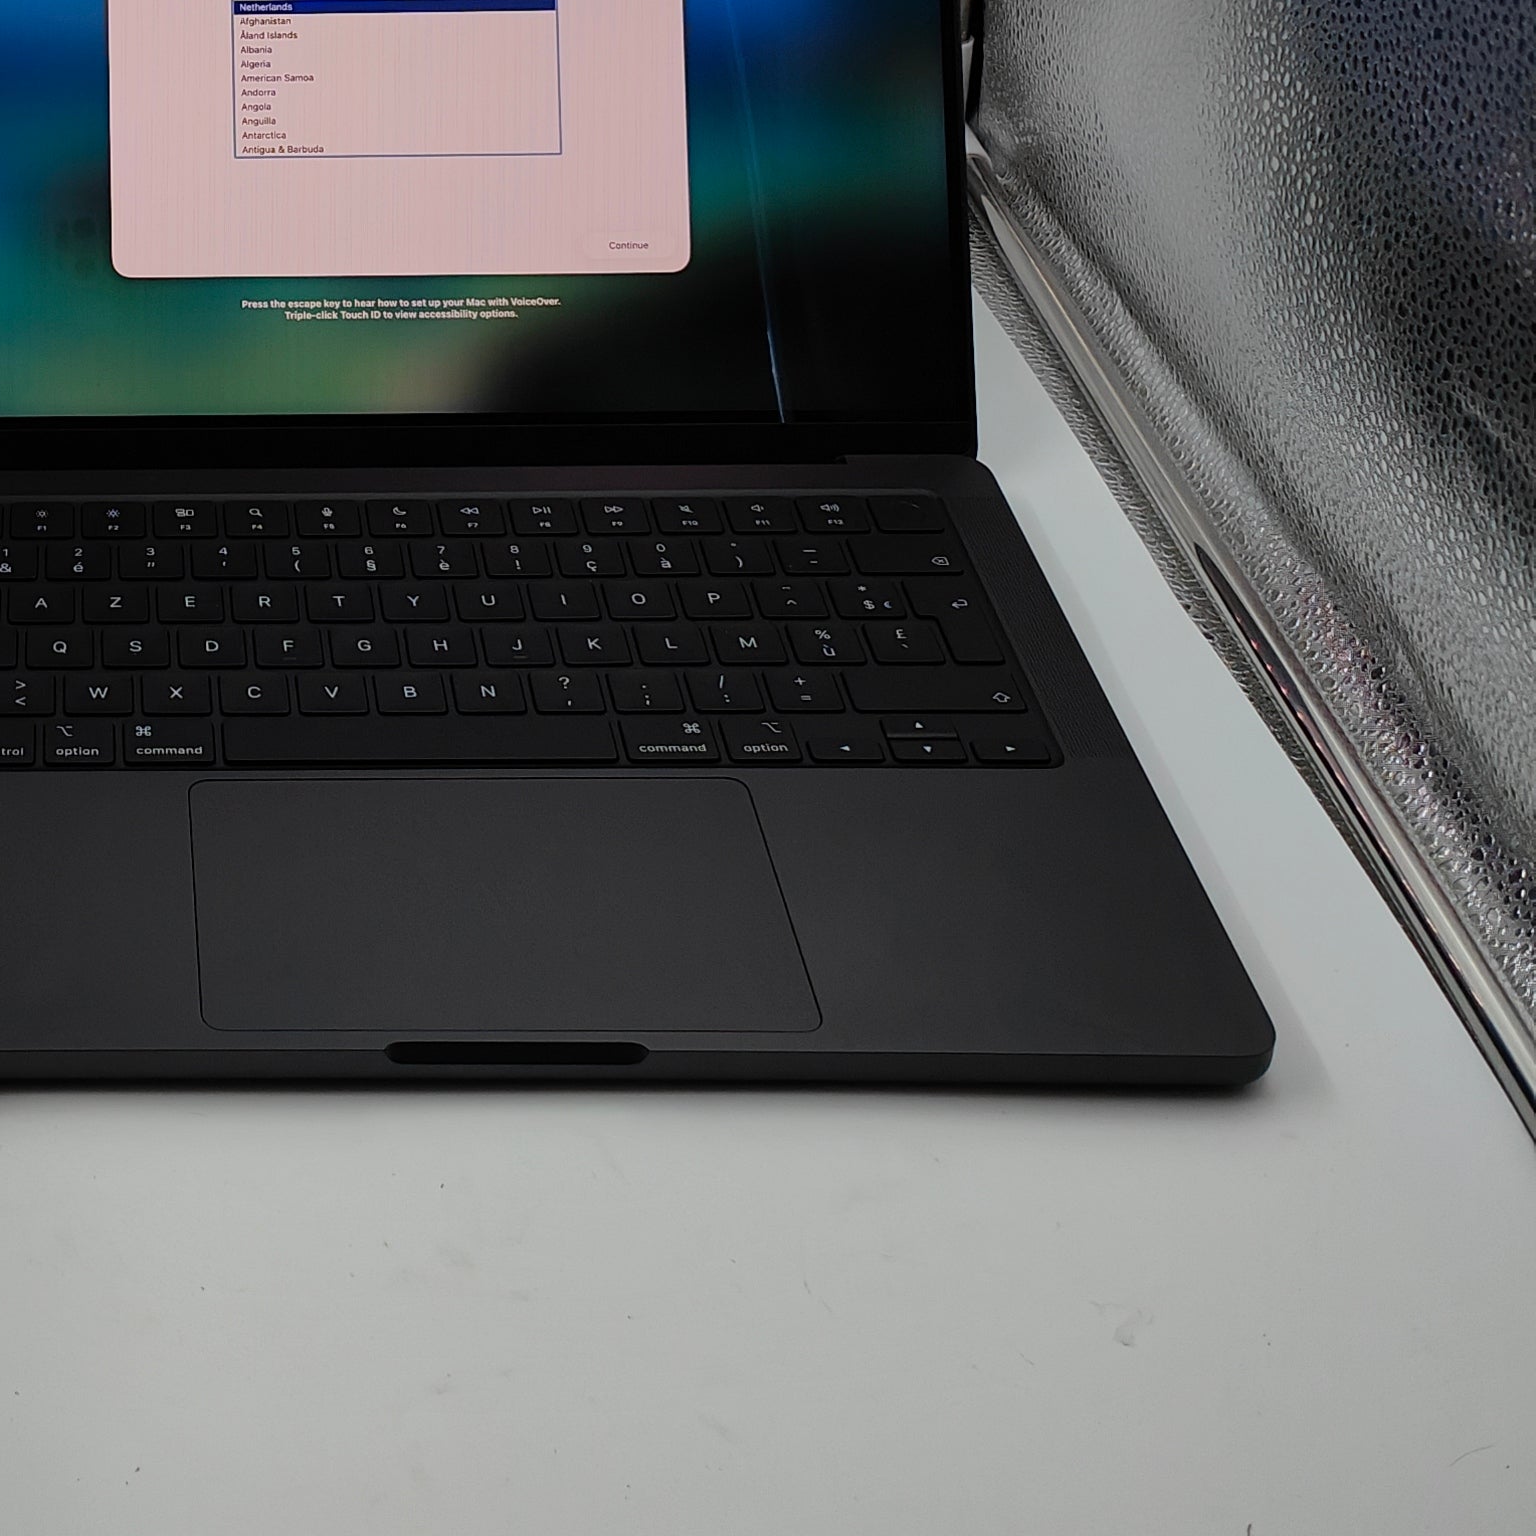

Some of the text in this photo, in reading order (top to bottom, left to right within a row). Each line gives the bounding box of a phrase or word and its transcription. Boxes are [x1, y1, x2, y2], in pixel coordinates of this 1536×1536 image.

[239, 2, 293, 12] Netherlands
[240, 17, 292, 27] Afghanistan
[266, 31, 298, 39] Islands
[240, 45, 273, 54] Albania
[240, 60, 271, 70] Algeria
[240, 73, 314, 82] American Samoa
[241, 88, 276, 97] Andorra
[241, 102, 272, 112] Angola
[241, 117, 276, 126] Anguilla
[242, 131, 287, 139] Antarctica
[242, 145, 324, 155] Antigua & Barbuda
[608, 240, 650, 250] Continue
[241, 297, 561, 310] Press the escape key to hear how to set up your Mac with VoiceOver.
[284, 309, 519, 321] Triple-click Touch ID to view accessibility options.
[2, 548, 8, 557] 1
[74, 548, 83, 557] 2
[146, 547, 155, 556] 3
[218, 547, 228, 555] 4
[291, 546, 301, 556] 5
[364, 546, 374, 555] 6
[437, 545, 446, 555] 7
[510, 545, 520, 554] 8
[582, 544, 593, 553] 9
[655, 543, 666, 553] 0
[73, 561, 84, 573] é
[439, 559, 450, 571] è
[34, 597, 48, 609] A
[109, 596, 122, 608] Z
[184, 595, 196, 608] E
[258, 595, 271, 608] R
[332, 595, 345, 607] T
[407, 595, 420, 607] Y
[481, 594, 496, 606] U
[631, 593, 646, 605] O
[707, 592, 721, 604] P
[52, 641, 67, 654] Q
[129, 640, 143, 652] S
[205, 640, 219, 652] D
[283, 640, 294, 652] F
[357, 639, 372, 652] G
[433, 639, 448, 651] H
[512, 639, 523, 651] J
[587, 638, 602, 650] K
[664, 637, 678, 649] L
[738, 636, 758, 649] M
[88, 686, 109, 699] W
[169, 686, 183, 699] X
[247, 686, 261, 699] C
[324, 686, 339, 699] V
[403, 686, 417, 698] B
[480, 685, 496, 698] N
[55, 746, 99, 757] option
[136, 746, 203, 755] command
[638, 743, 707, 753] command
[743, 743, 789, 754] option
